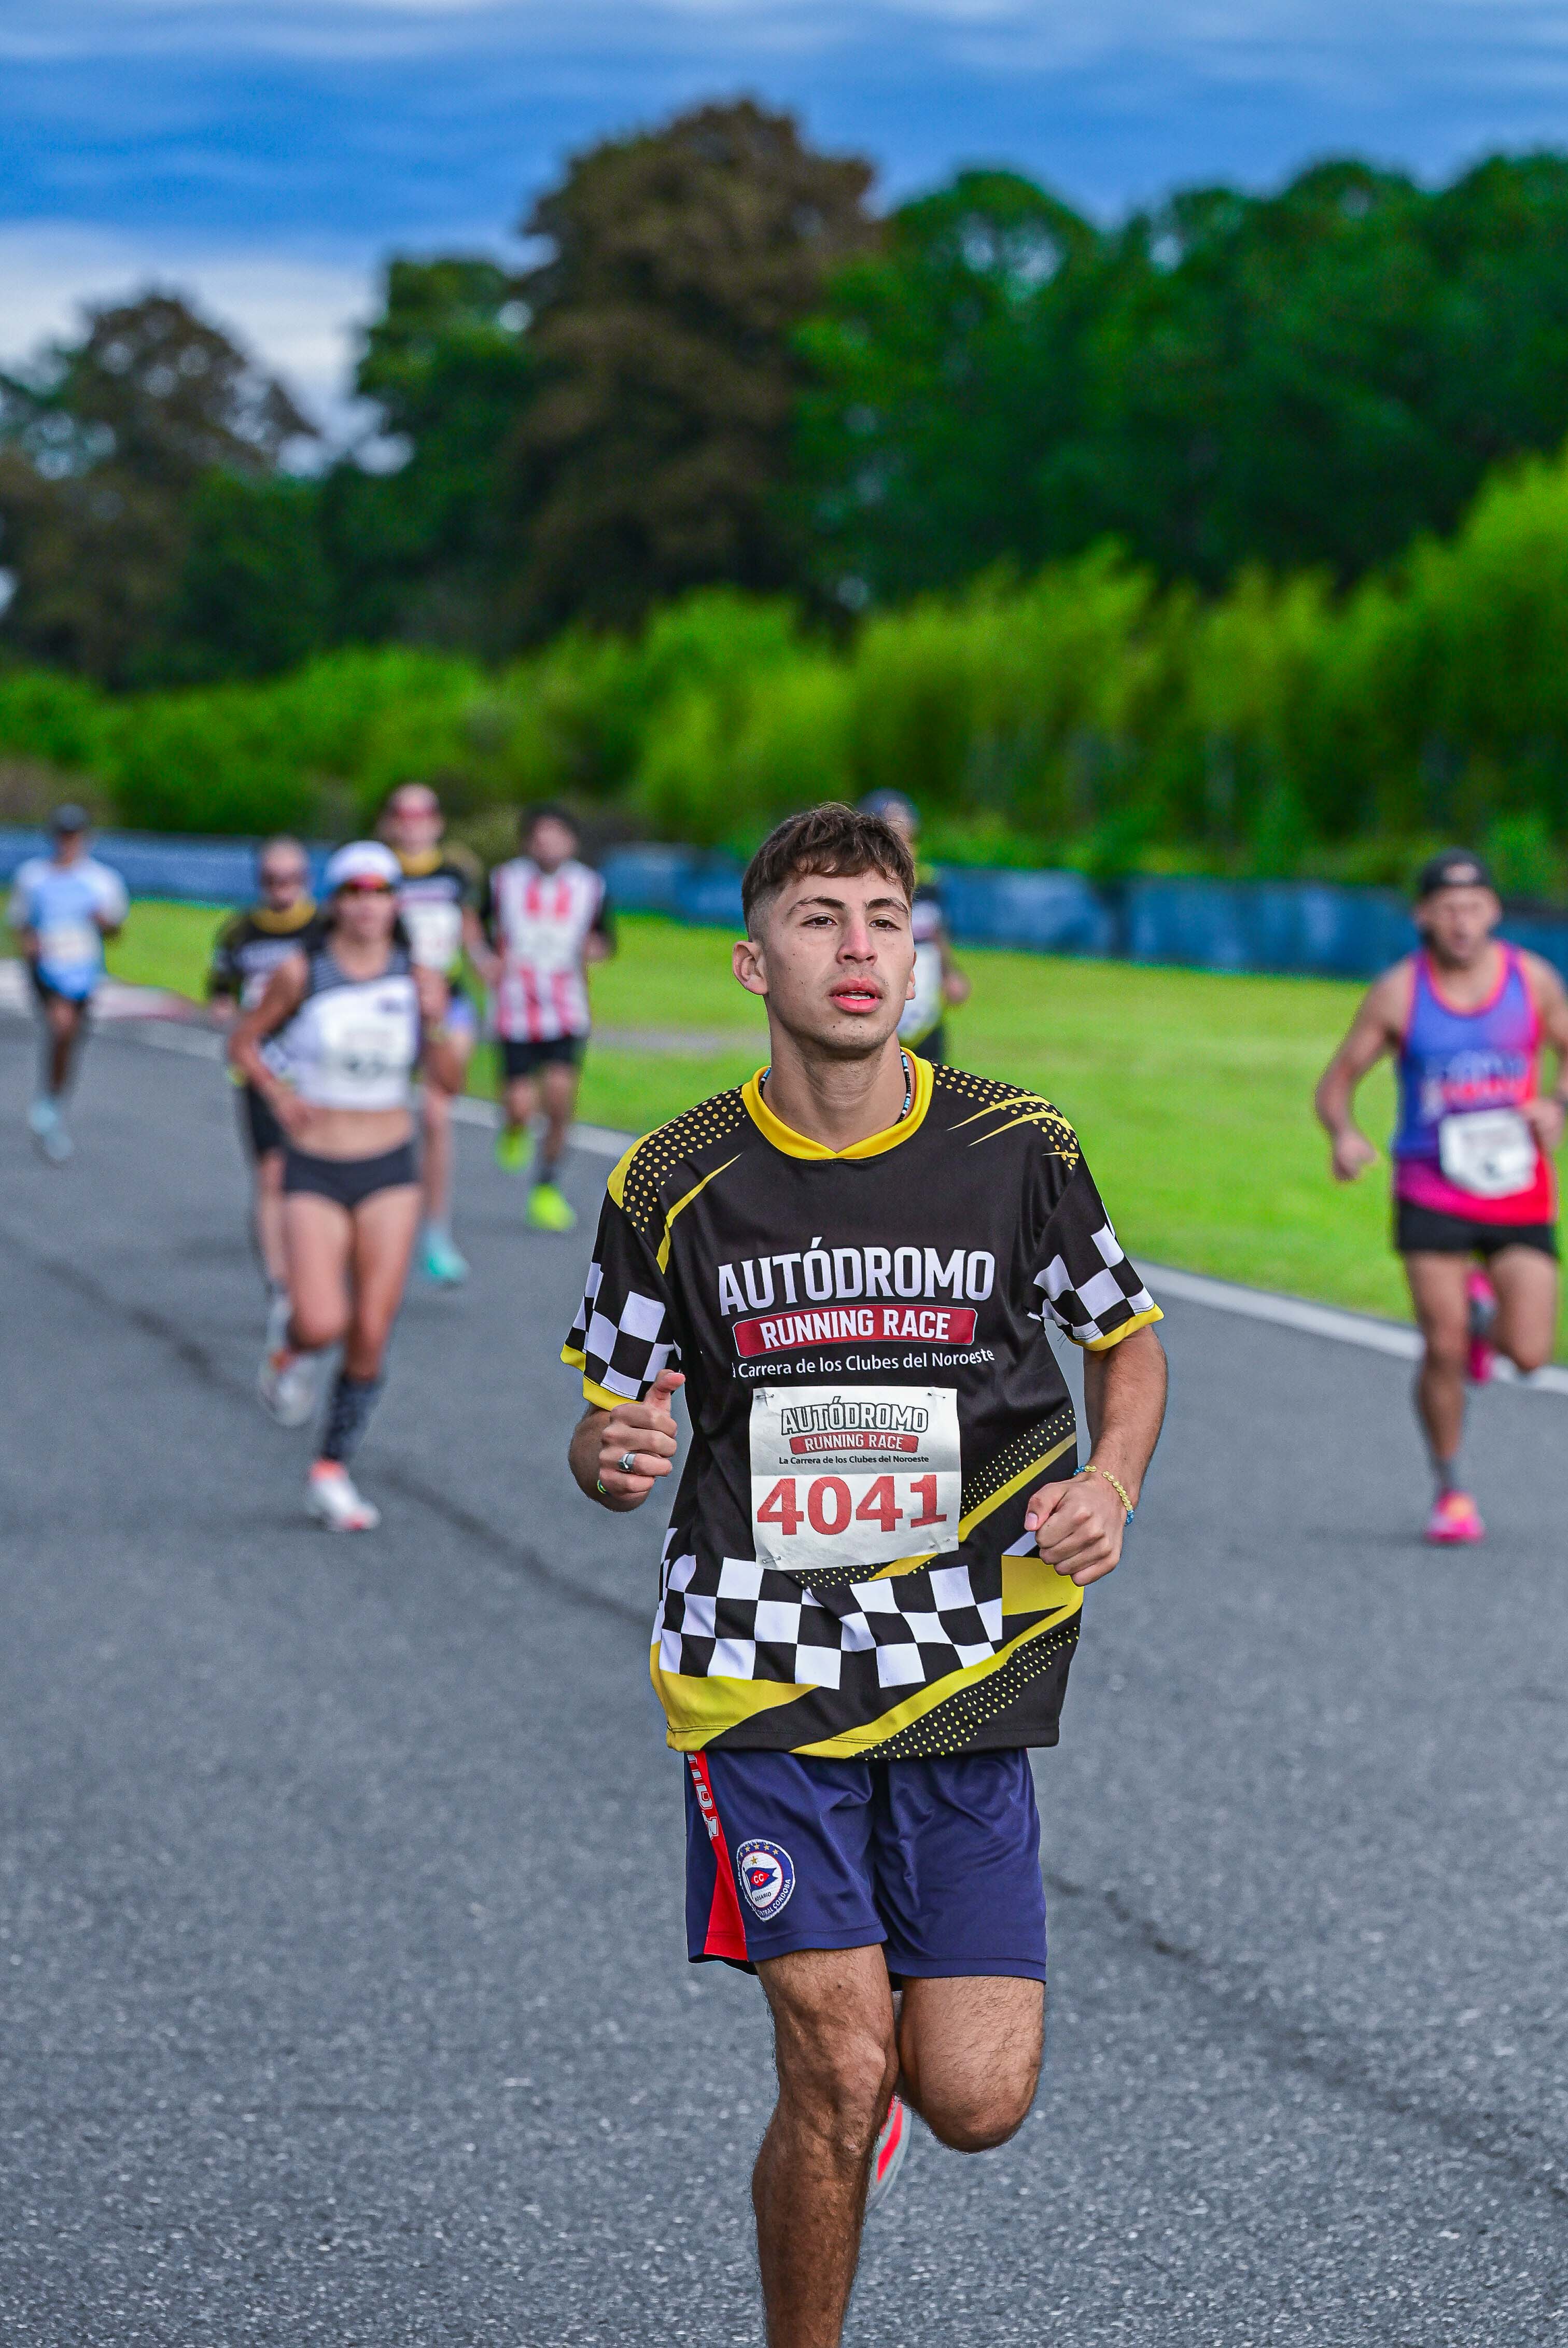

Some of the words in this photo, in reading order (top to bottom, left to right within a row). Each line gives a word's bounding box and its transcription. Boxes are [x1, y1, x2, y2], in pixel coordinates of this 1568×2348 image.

[718, 1236, 995, 1316] AUTÓDROMO
[759, 1309, 874, 1349] RUNNING
[883, 1309, 950, 1340] RACE
[738, 1363, 792, 1378] Carrera
[796, 1358, 816, 1374] de
[820, 1357, 842, 1373] los
[846, 1354, 899, 1371] Clubes
[903, 1353, 928, 1368] del
[932, 1348, 995, 1367] Noroeste
[781, 1396, 929, 1436] AUTÓDROMO
[804, 1433, 864, 1451] RUNNING
[868, 1434, 904, 1450] RACE
[822, 1456, 834, 1464] de
[757, 1474, 947, 1535] 4041
